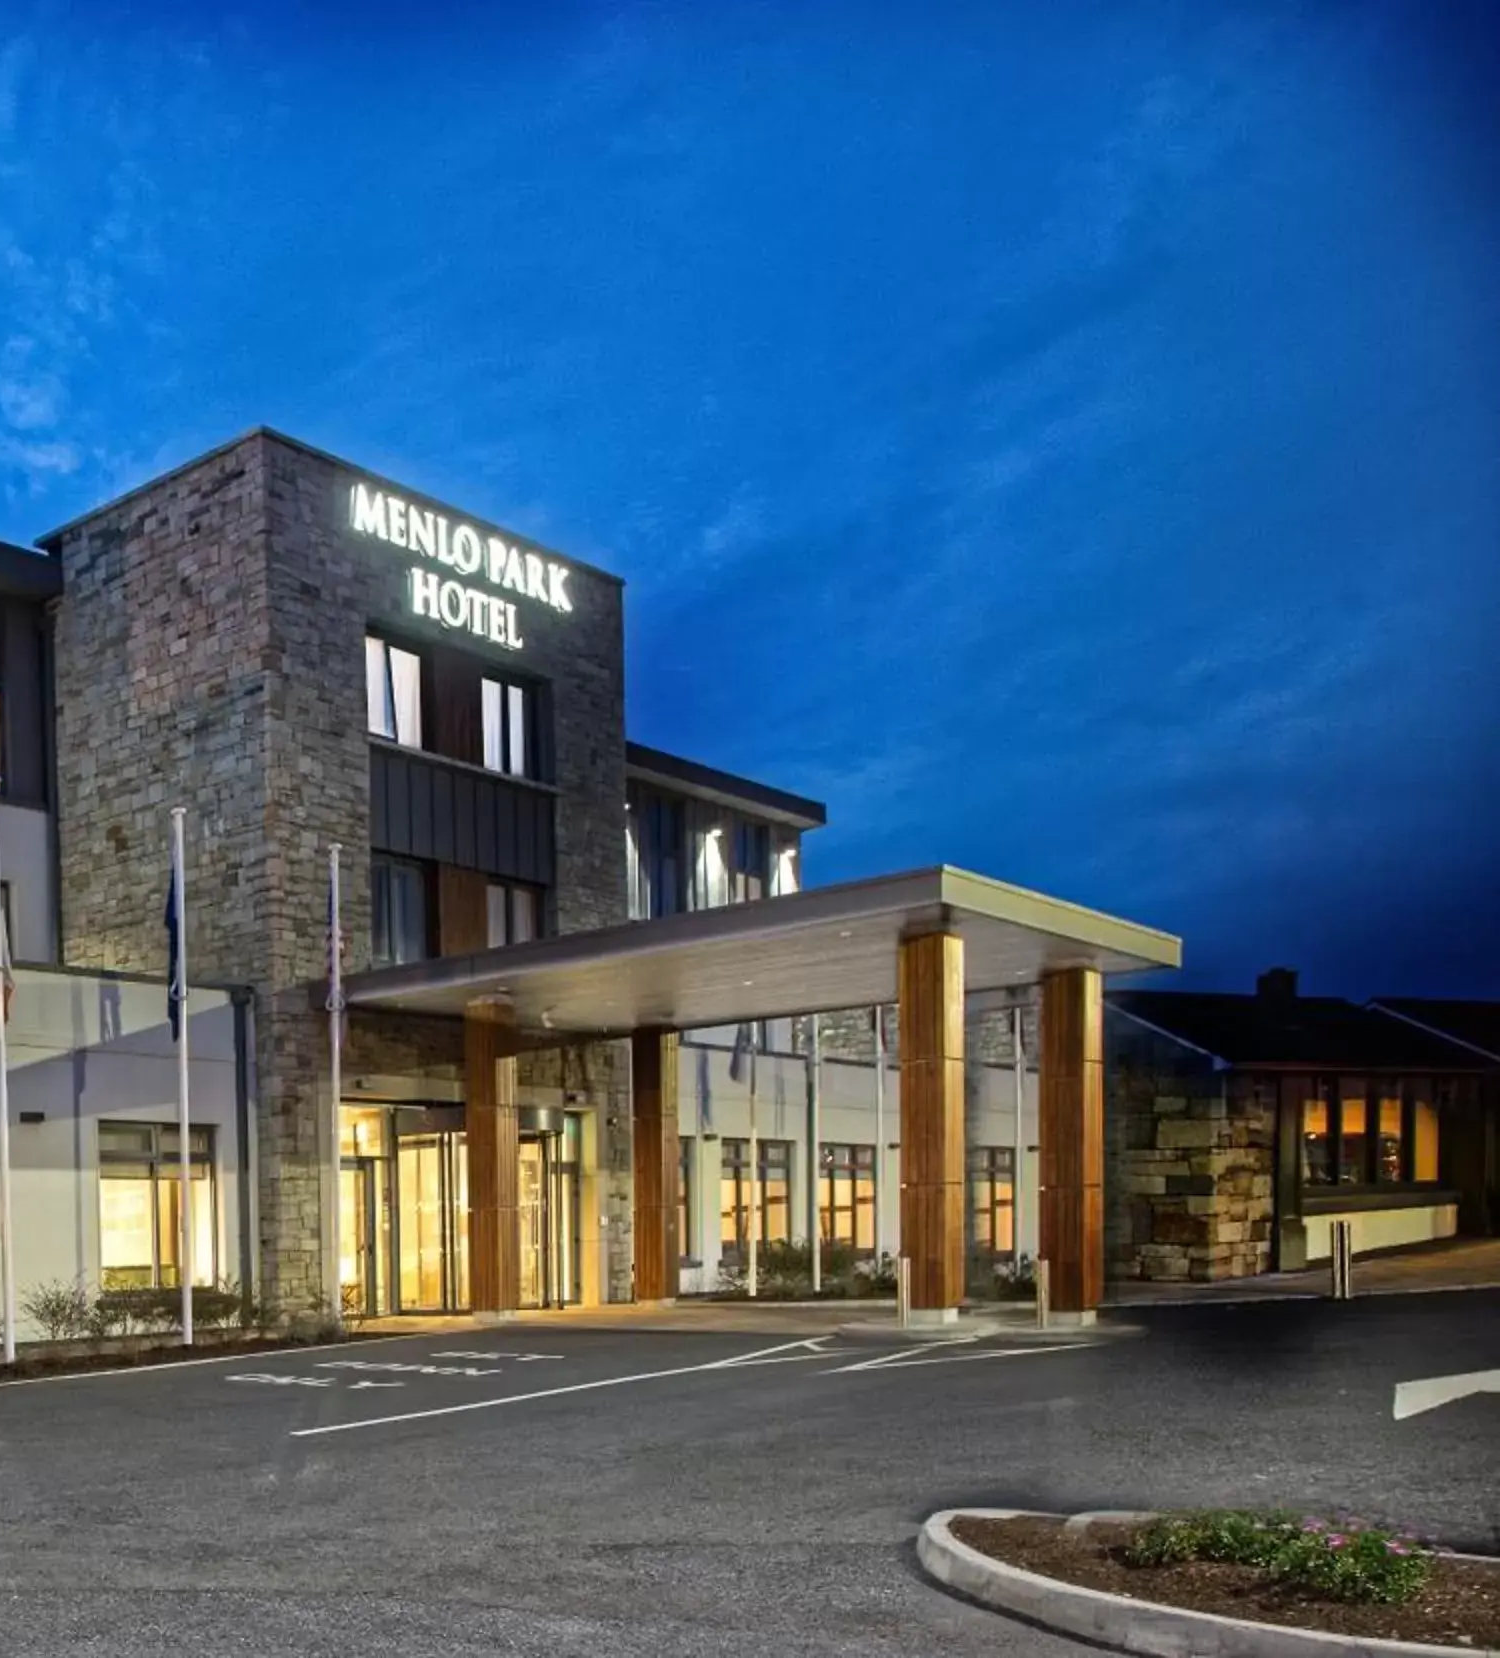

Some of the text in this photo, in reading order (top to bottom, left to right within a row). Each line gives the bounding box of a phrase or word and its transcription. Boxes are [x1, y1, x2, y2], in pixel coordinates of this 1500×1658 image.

[351, 483, 573, 613] MENLO PARK
[408, 566, 523, 650] HOTEL
